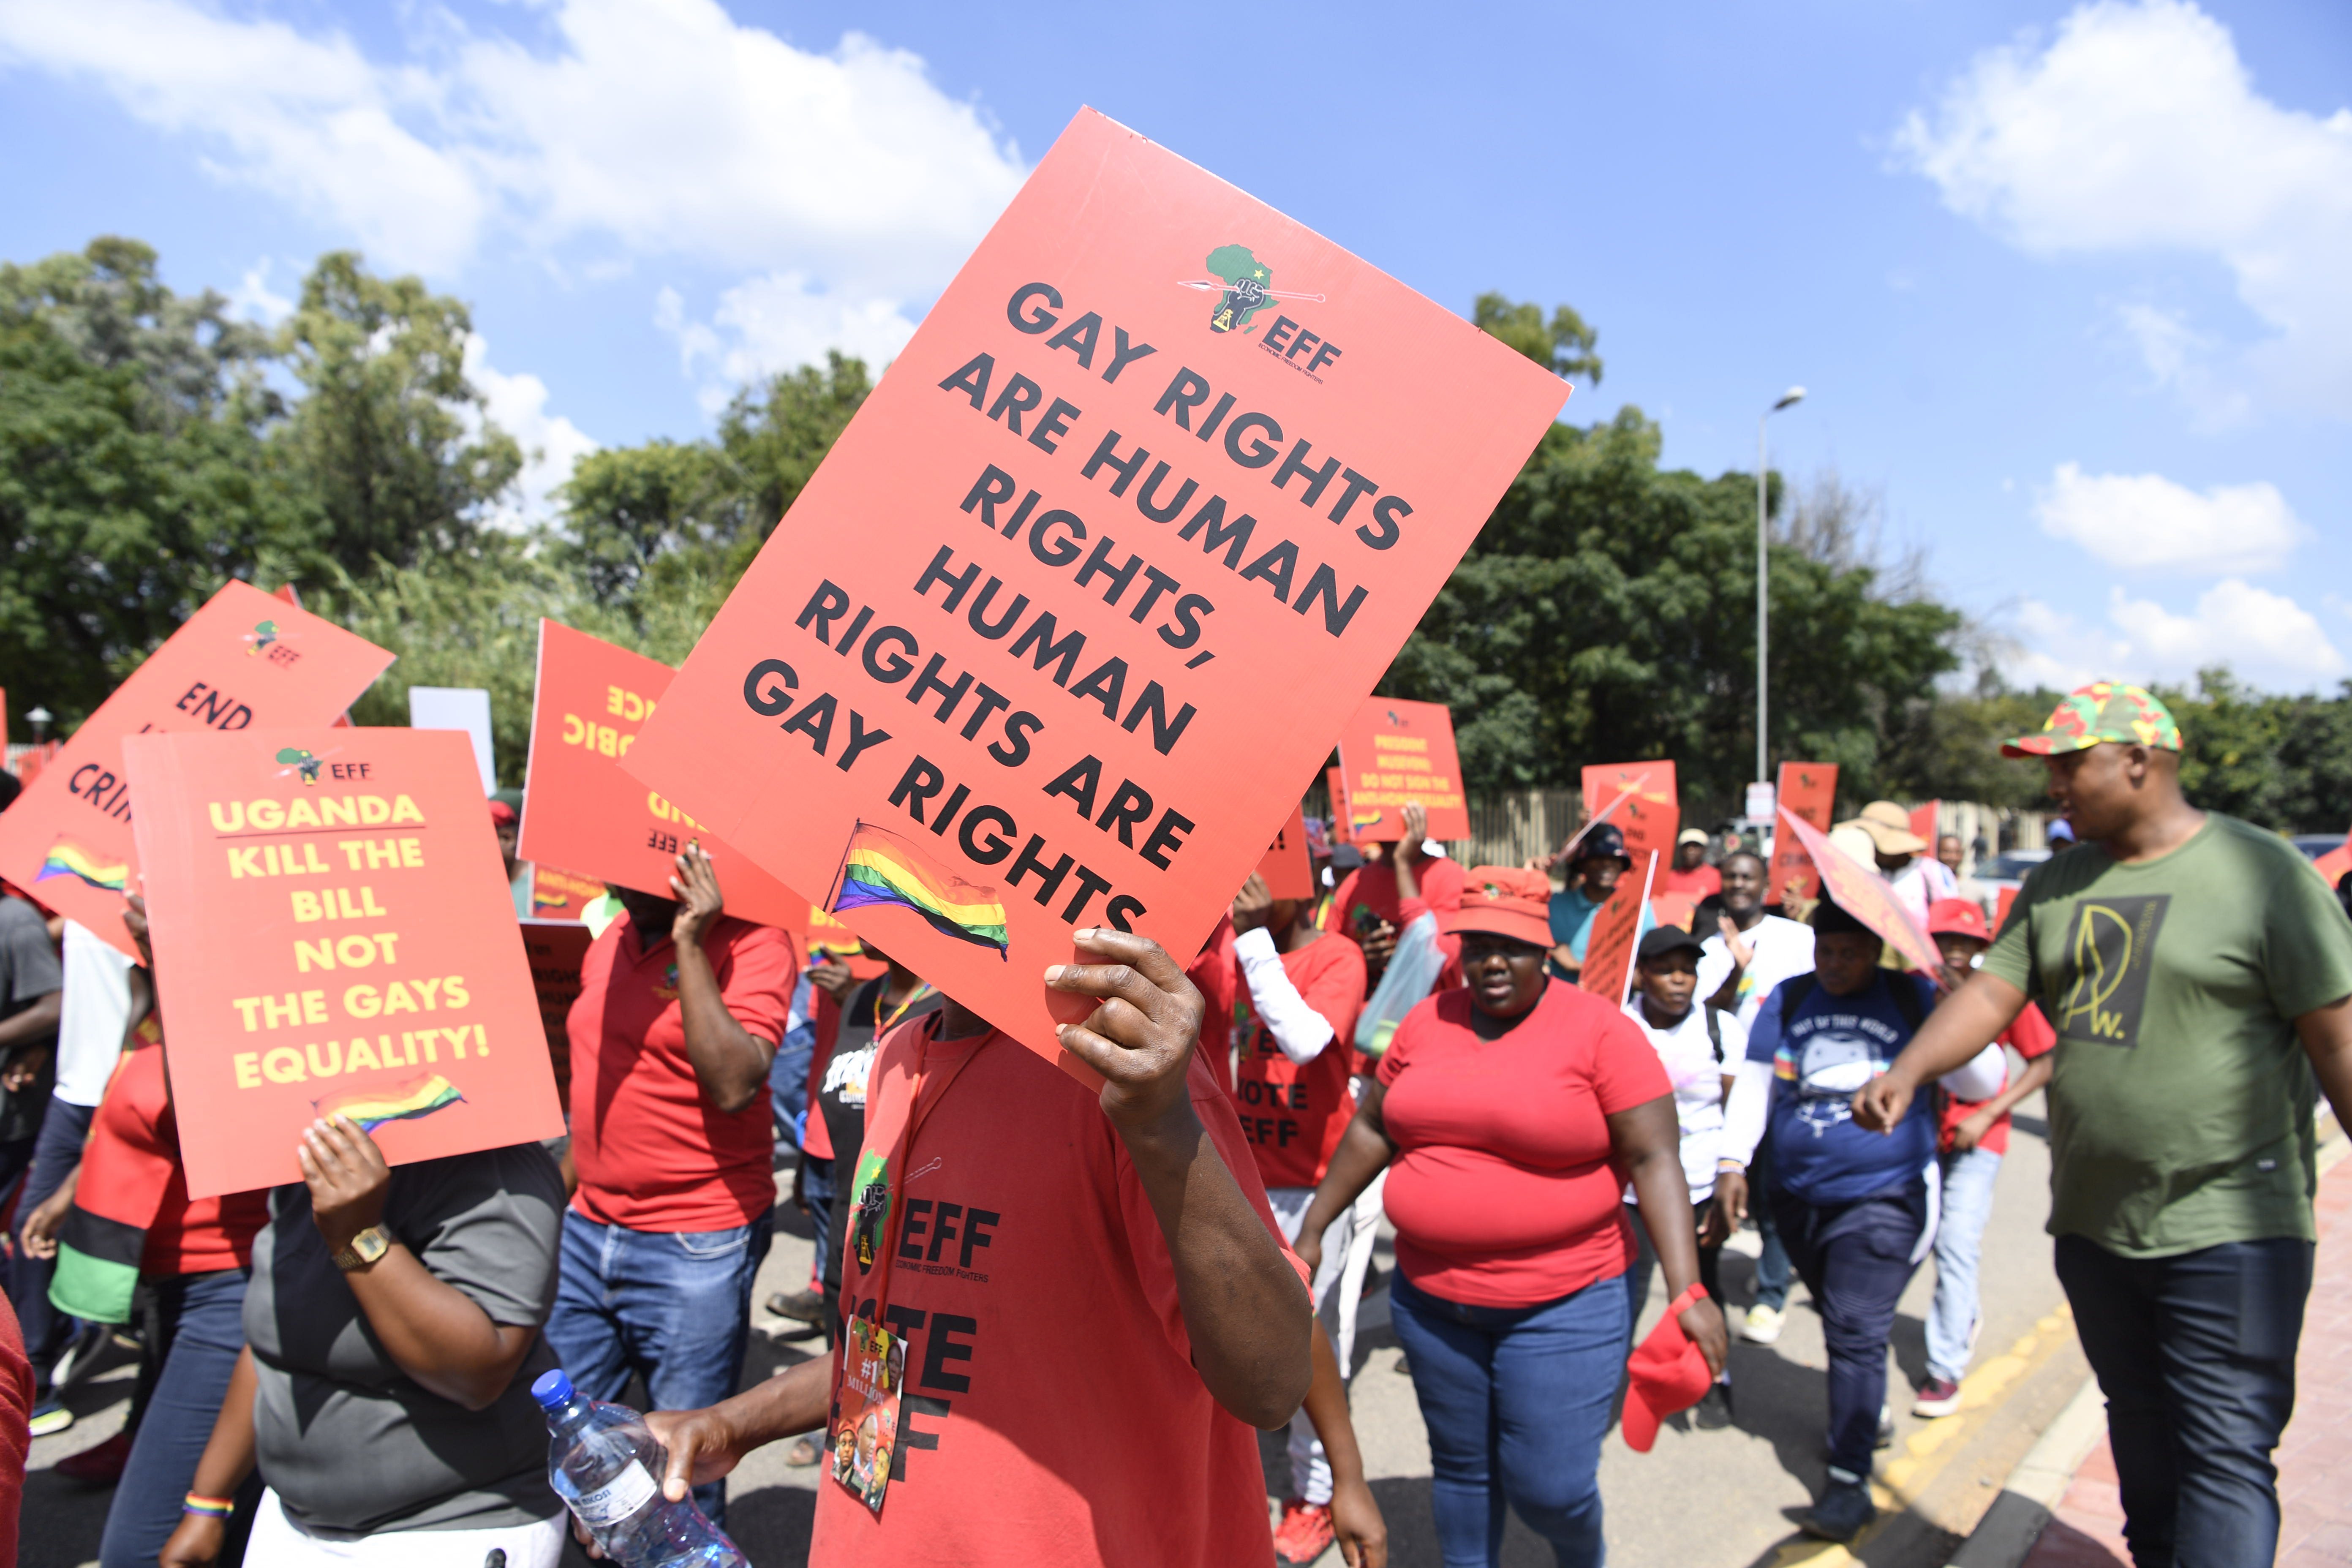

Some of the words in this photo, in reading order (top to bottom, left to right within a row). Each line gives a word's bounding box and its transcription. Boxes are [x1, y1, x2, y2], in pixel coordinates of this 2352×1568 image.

[1258, 343, 1282, 359] ECONOMIC
[1281, 357, 1302, 372] FREEDOM
[1302, 369, 1323, 385] FIGHTERS
[1262, 315, 1342, 372] EFF
[1007, 282, 1157, 384] GAY
[1153, 366, 1413, 550] RIGHTS
[938, 352, 1082, 455] ARE
[1080, 429, 1369, 638] HUMAN
[960, 463, 1216, 670] RIGHTS,
[913, 544, 1198, 756] HUMAN
[176, 682, 253, 730] END
[743, 659, 892, 772] GAY
[795, 579, 1045, 767] RIGHTS
[1042, 754, 1195, 871] ARE
[332, 763, 372, 779] EFF
[208, 794, 425, 833] UGANDA
[226, 842, 330, 879] KILL
[338, 837, 425, 871] THE
[290, 886, 387, 923] BILL
[293, 932, 399, 973] NOT
[232, 989, 329, 1032] THE
[343, 975, 470, 1019] GAYS
[232, 1023, 490, 1090] EQUALITY!
[898, 1198, 1001, 1268] EFF
[896, 1259, 922, 1272] ECONOMIC
[922, 1264, 955, 1276] FREEDOM
[956, 1269, 989, 1283] FIGHTERS
[870, 1339, 883, 1353] EFF
[847, 1375, 885, 1406] MILLION
[860, 1357, 878, 1384] #1
